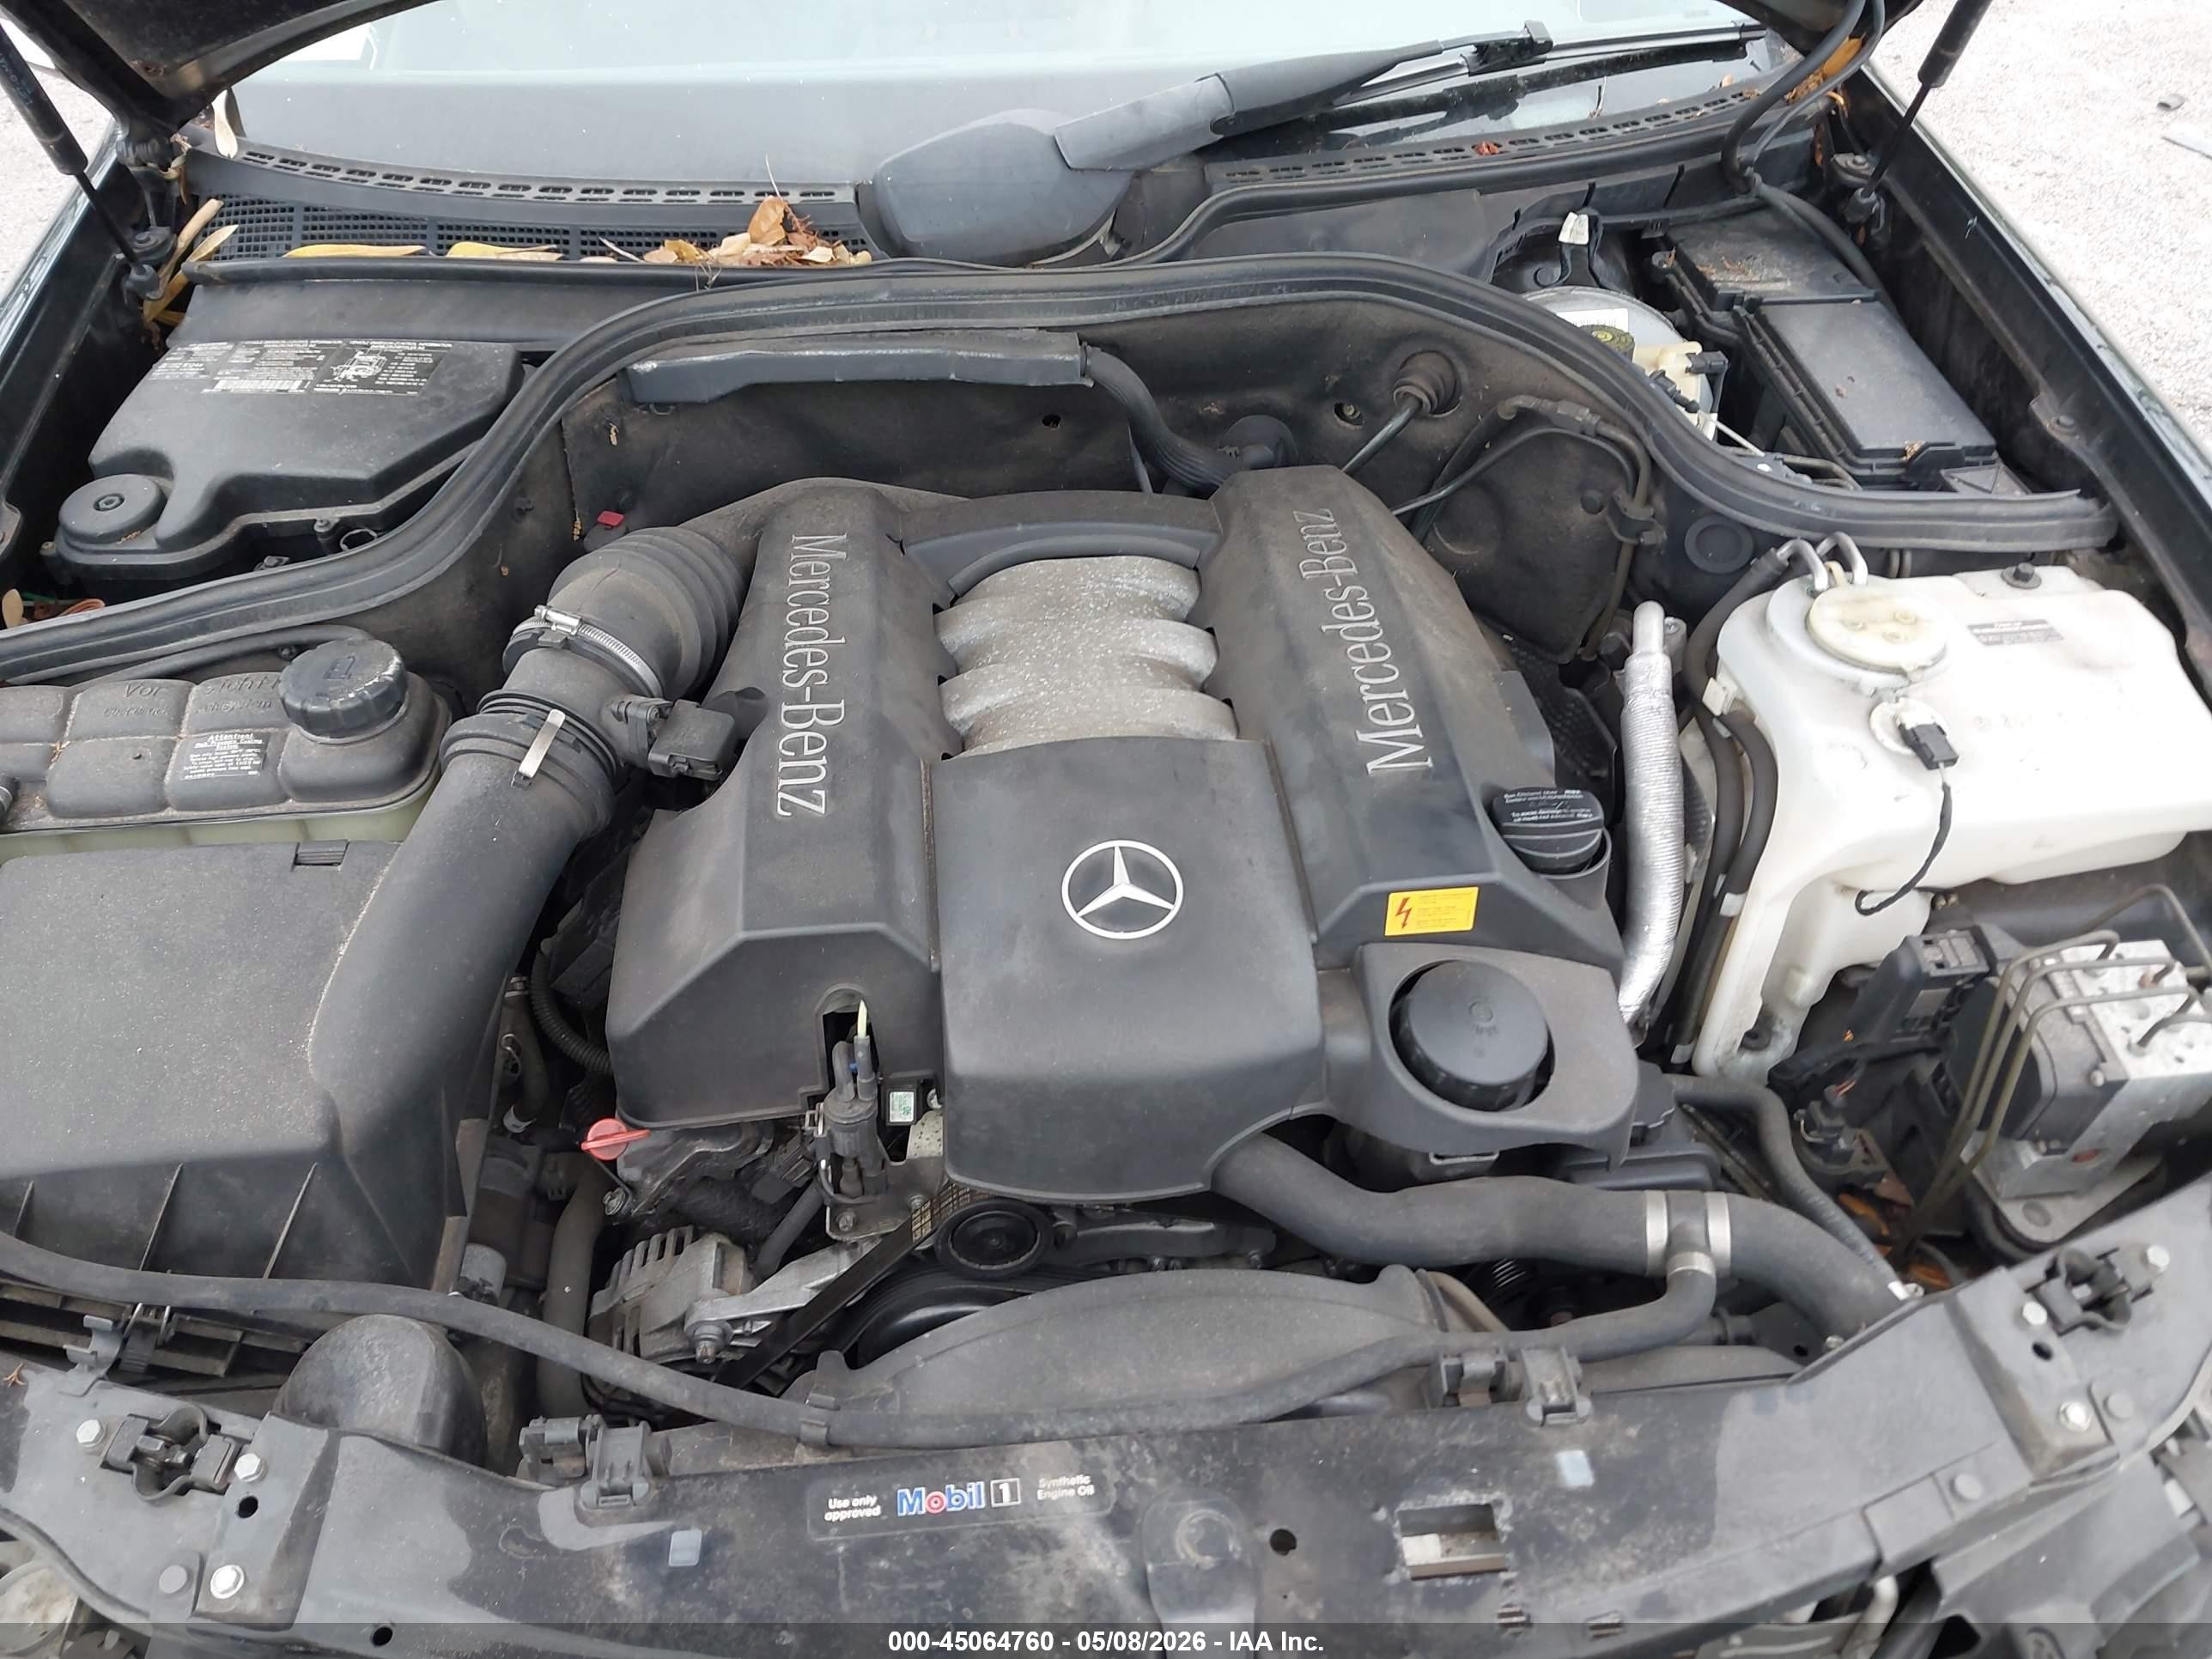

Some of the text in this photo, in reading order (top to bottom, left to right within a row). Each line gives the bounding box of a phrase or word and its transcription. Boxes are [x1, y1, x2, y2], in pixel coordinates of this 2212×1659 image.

[1293, 508, 1433, 776] Mercedes-Benz
[776, 532, 848, 816] Mercedes-Benz
[1038, 1474, 1091, 1489] Synthetic
[828, 1494, 878, 1509] Use only
[896, 1481, 986, 1516] Mobil
[1036, 1488, 1076, 1501] Engine
[824, 1505, 881, 1522] approved
